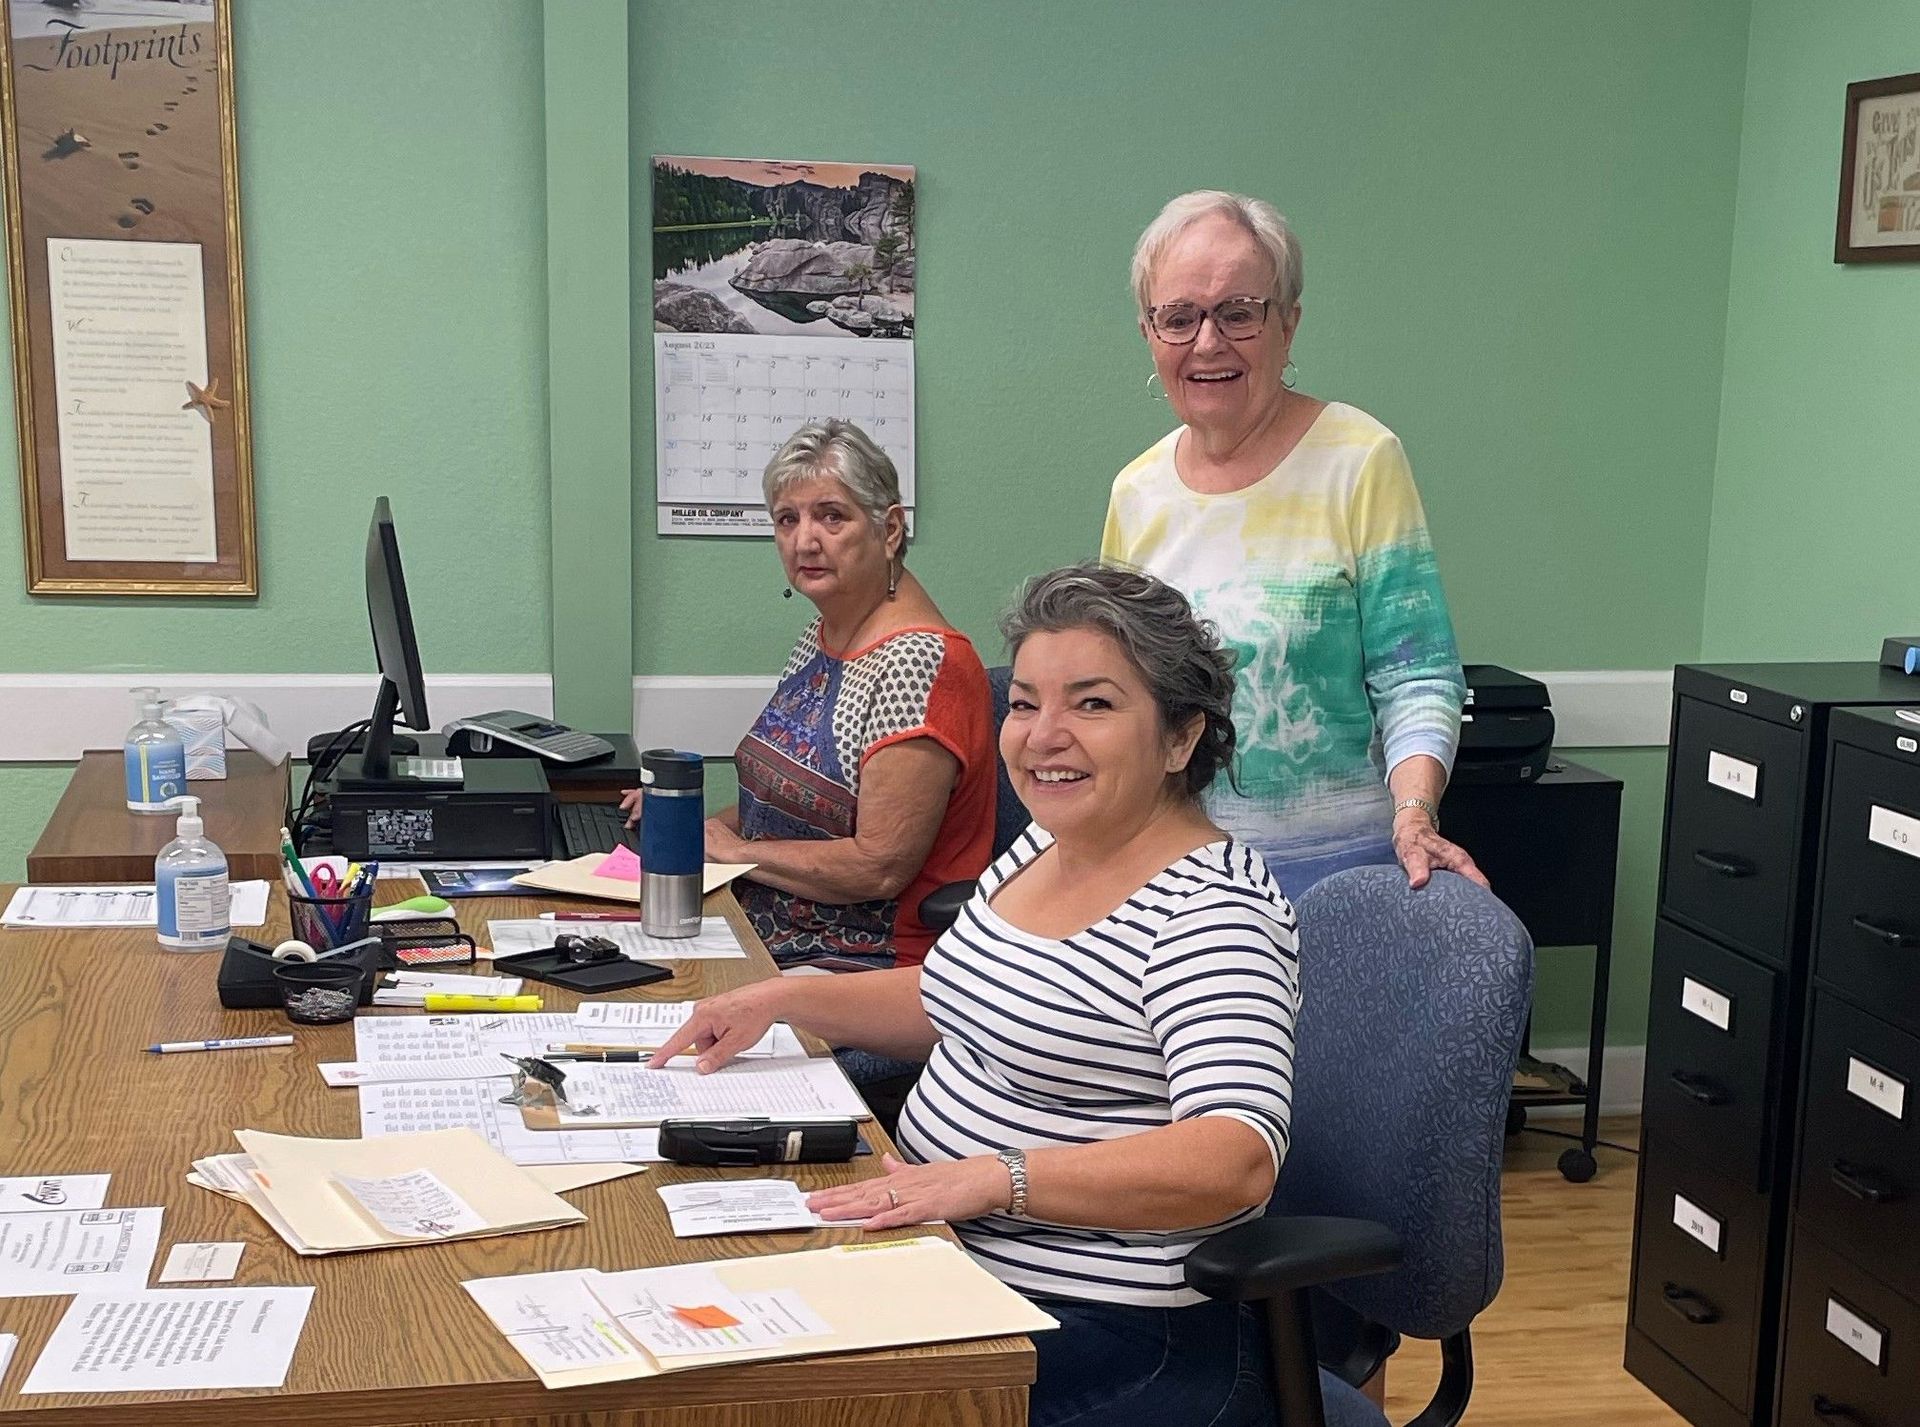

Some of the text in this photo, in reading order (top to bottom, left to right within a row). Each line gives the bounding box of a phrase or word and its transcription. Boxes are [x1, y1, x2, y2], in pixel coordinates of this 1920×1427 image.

[24, 19, 202, 80] Footprints
[664, 341, 691, 350] August
[807, 389, 816, 397] 10
[841, 390, 850, 398] 11
[702, 413, 712, 421] 14
[737, 415, 747, 423] 15
[772, 416, 782, 424] 16
[876, 418, 885, 426] 19
[702, 441, 712, 450] 21
[737, 442, 748, 450] 22
[702, 469, 713, 477] 28
[738, 470, 748, 478] 29
[672, 509, 744, 518] MILLEN OIL COMPANY
[1892, 829, 1908, 844] C-D
